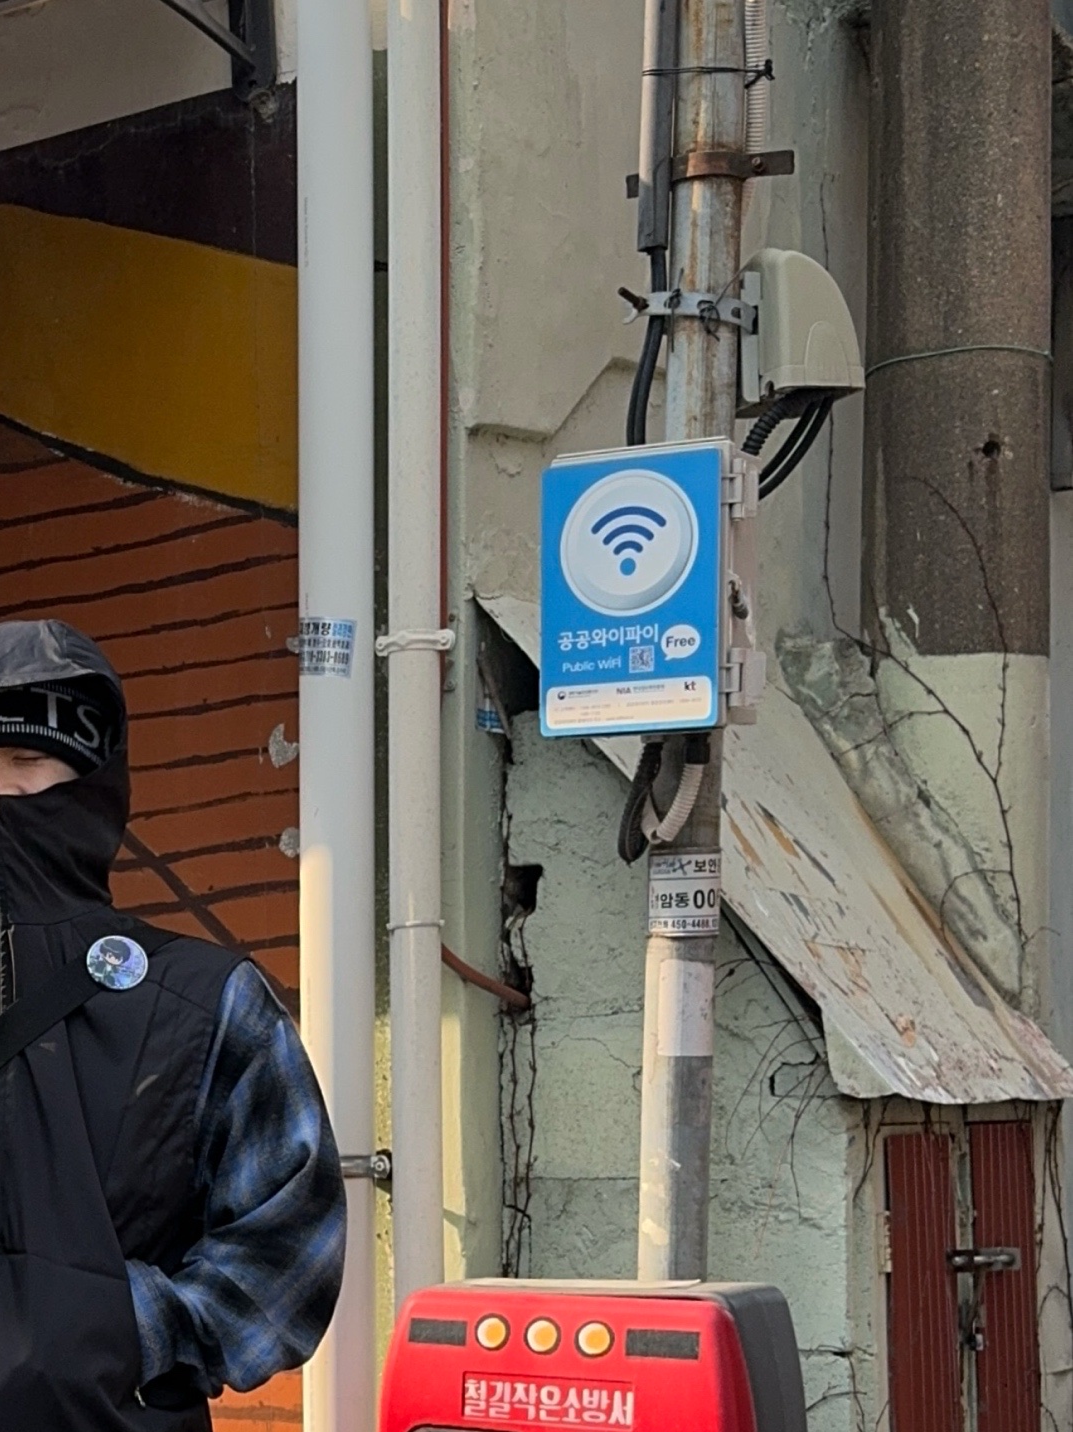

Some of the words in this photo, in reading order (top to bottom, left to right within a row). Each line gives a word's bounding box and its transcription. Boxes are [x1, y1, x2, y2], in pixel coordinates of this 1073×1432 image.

[558, 624, 658, 650] 공공와이파이
[665, 636, 696, 648] Free
[562, 659, 595, 673] Public
[684, 681, 696, 692] kt
[464, 1379, 634, 1425] 철길작은소방서
